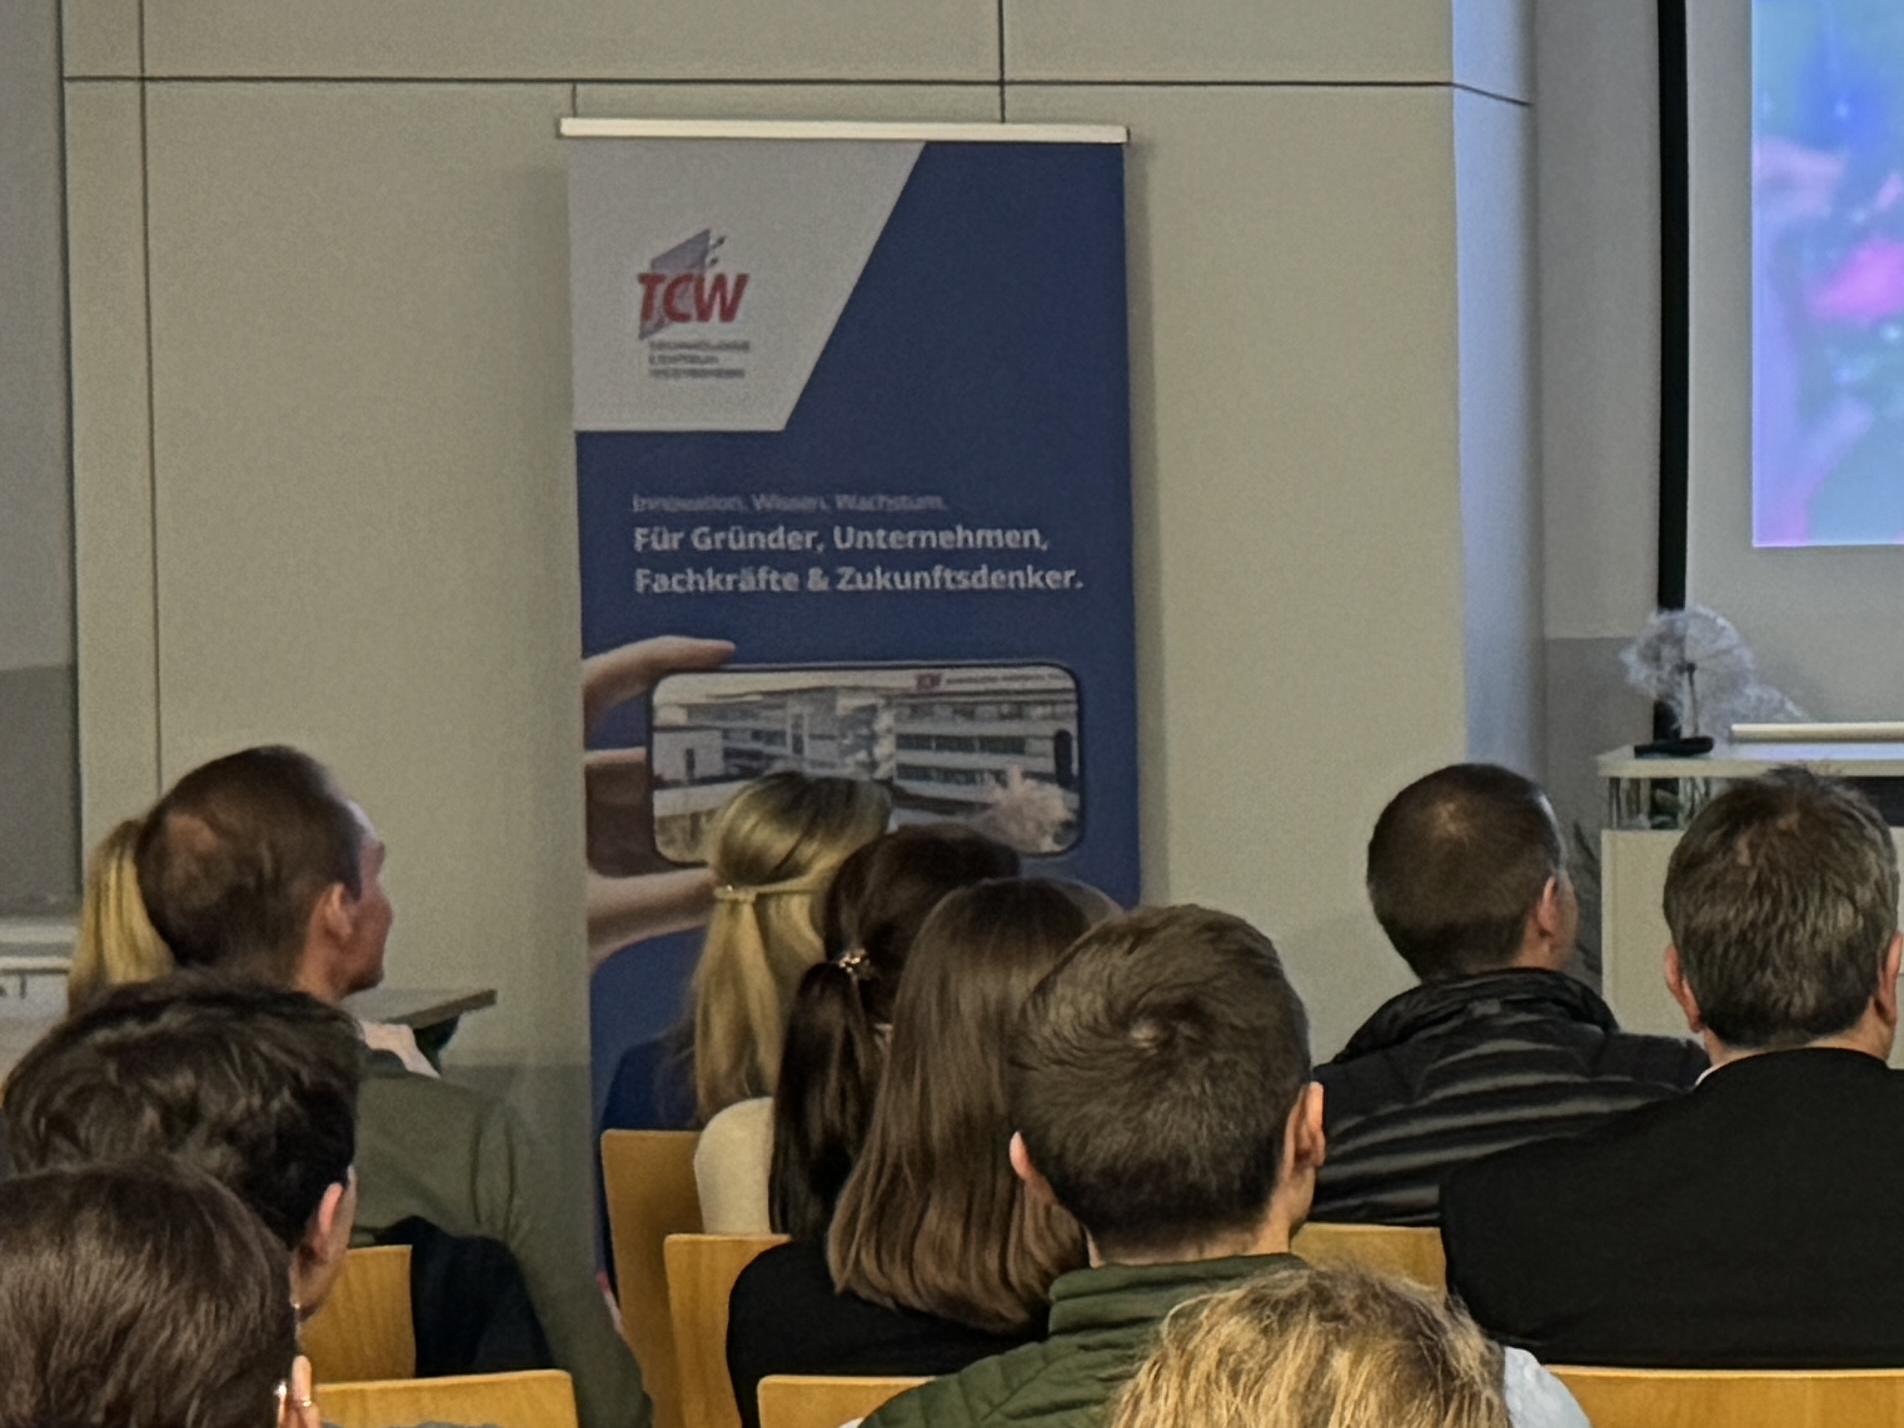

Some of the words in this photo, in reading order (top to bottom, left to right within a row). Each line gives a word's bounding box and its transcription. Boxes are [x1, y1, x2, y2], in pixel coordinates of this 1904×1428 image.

[636, 272, 750, 324] TCW
[633, 525, 684, 553] Für
[691, 525, 825, 554] Gründer,
[832, 524, 1050, 552] Unternehmen,
[634, 566, 800, 595] Fachkräfte
[806, 567, 830, 592] &
[836, 564, 1084, 593] Zukunftsdenker.
